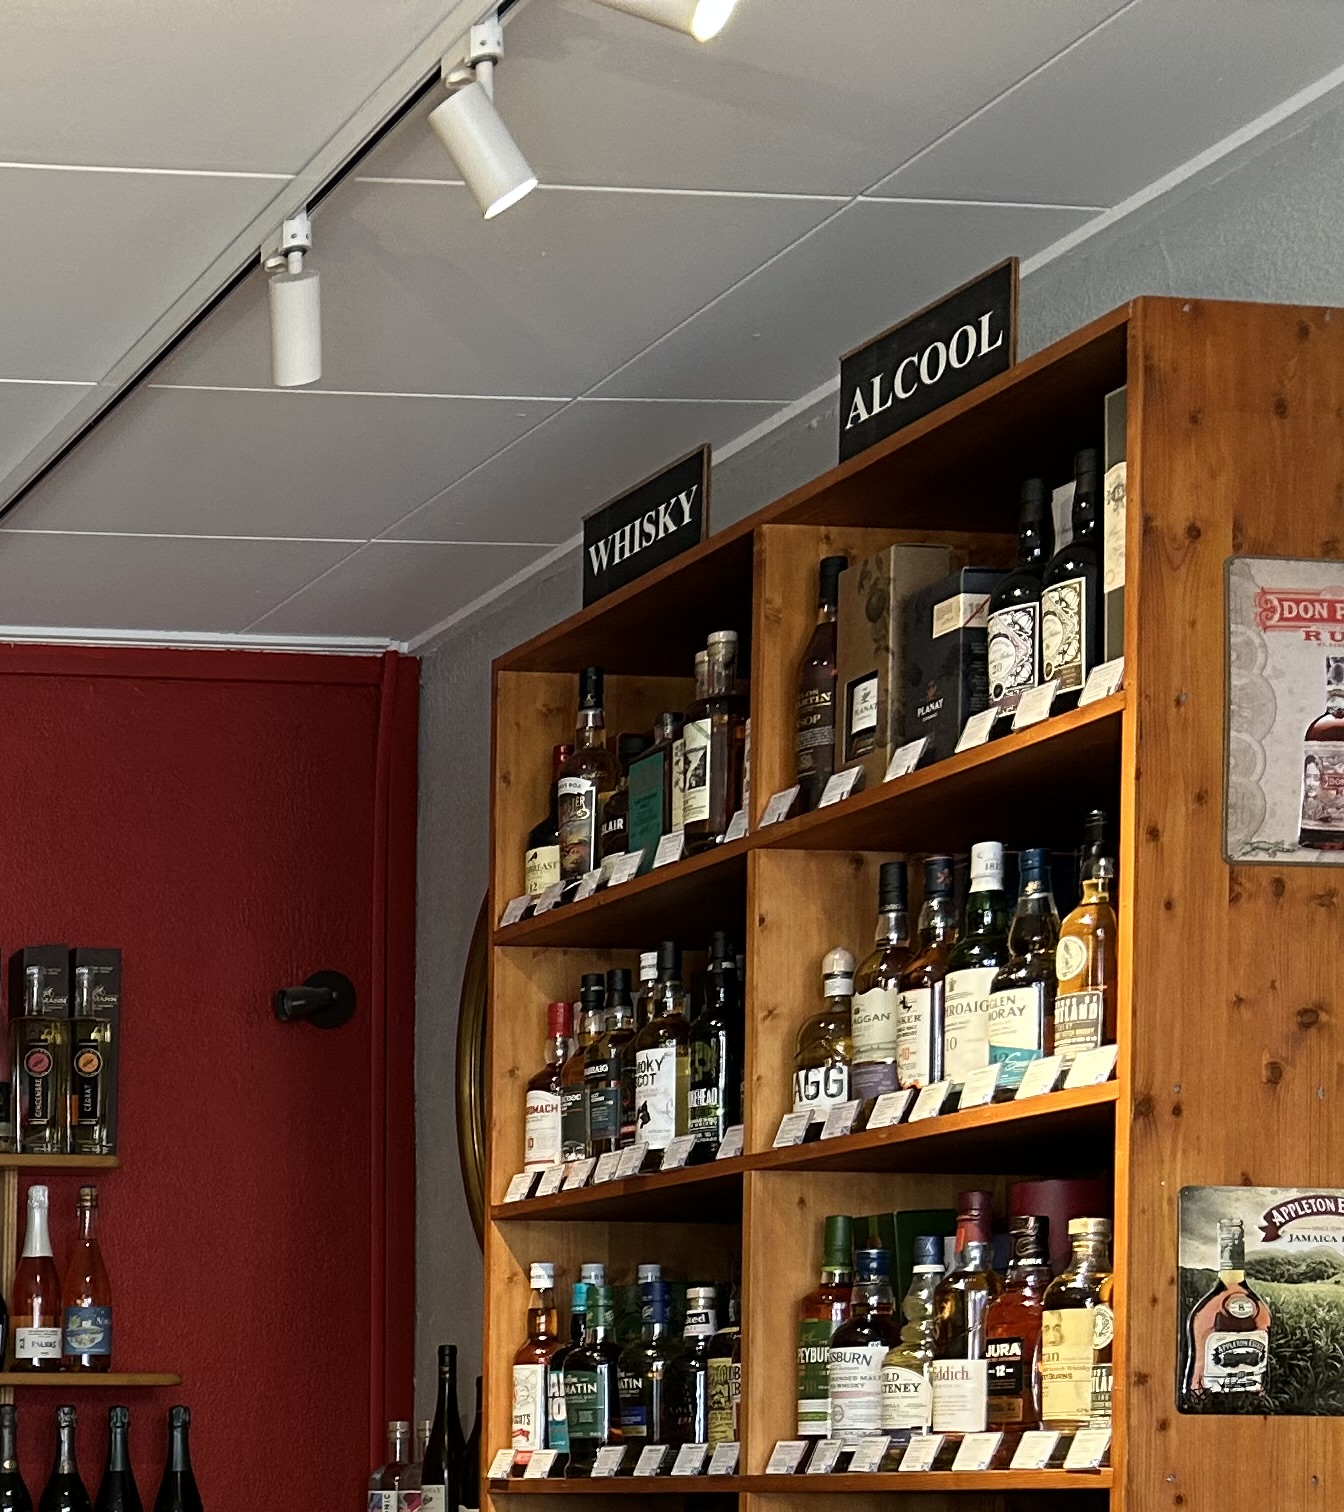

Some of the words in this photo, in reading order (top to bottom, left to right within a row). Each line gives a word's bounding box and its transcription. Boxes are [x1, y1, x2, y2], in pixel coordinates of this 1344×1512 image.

[844, 310, 1003, 430] ALCOOL
[588, 484, 698, 577] WHISKY
[1283, 598, 1329, 619] DON
[1271, 1198, 1335, 1226] APPLETON
[1288, 1233, 1337, 1243] JAMAICA
[986, 1342, 1021, 1356] JURA
